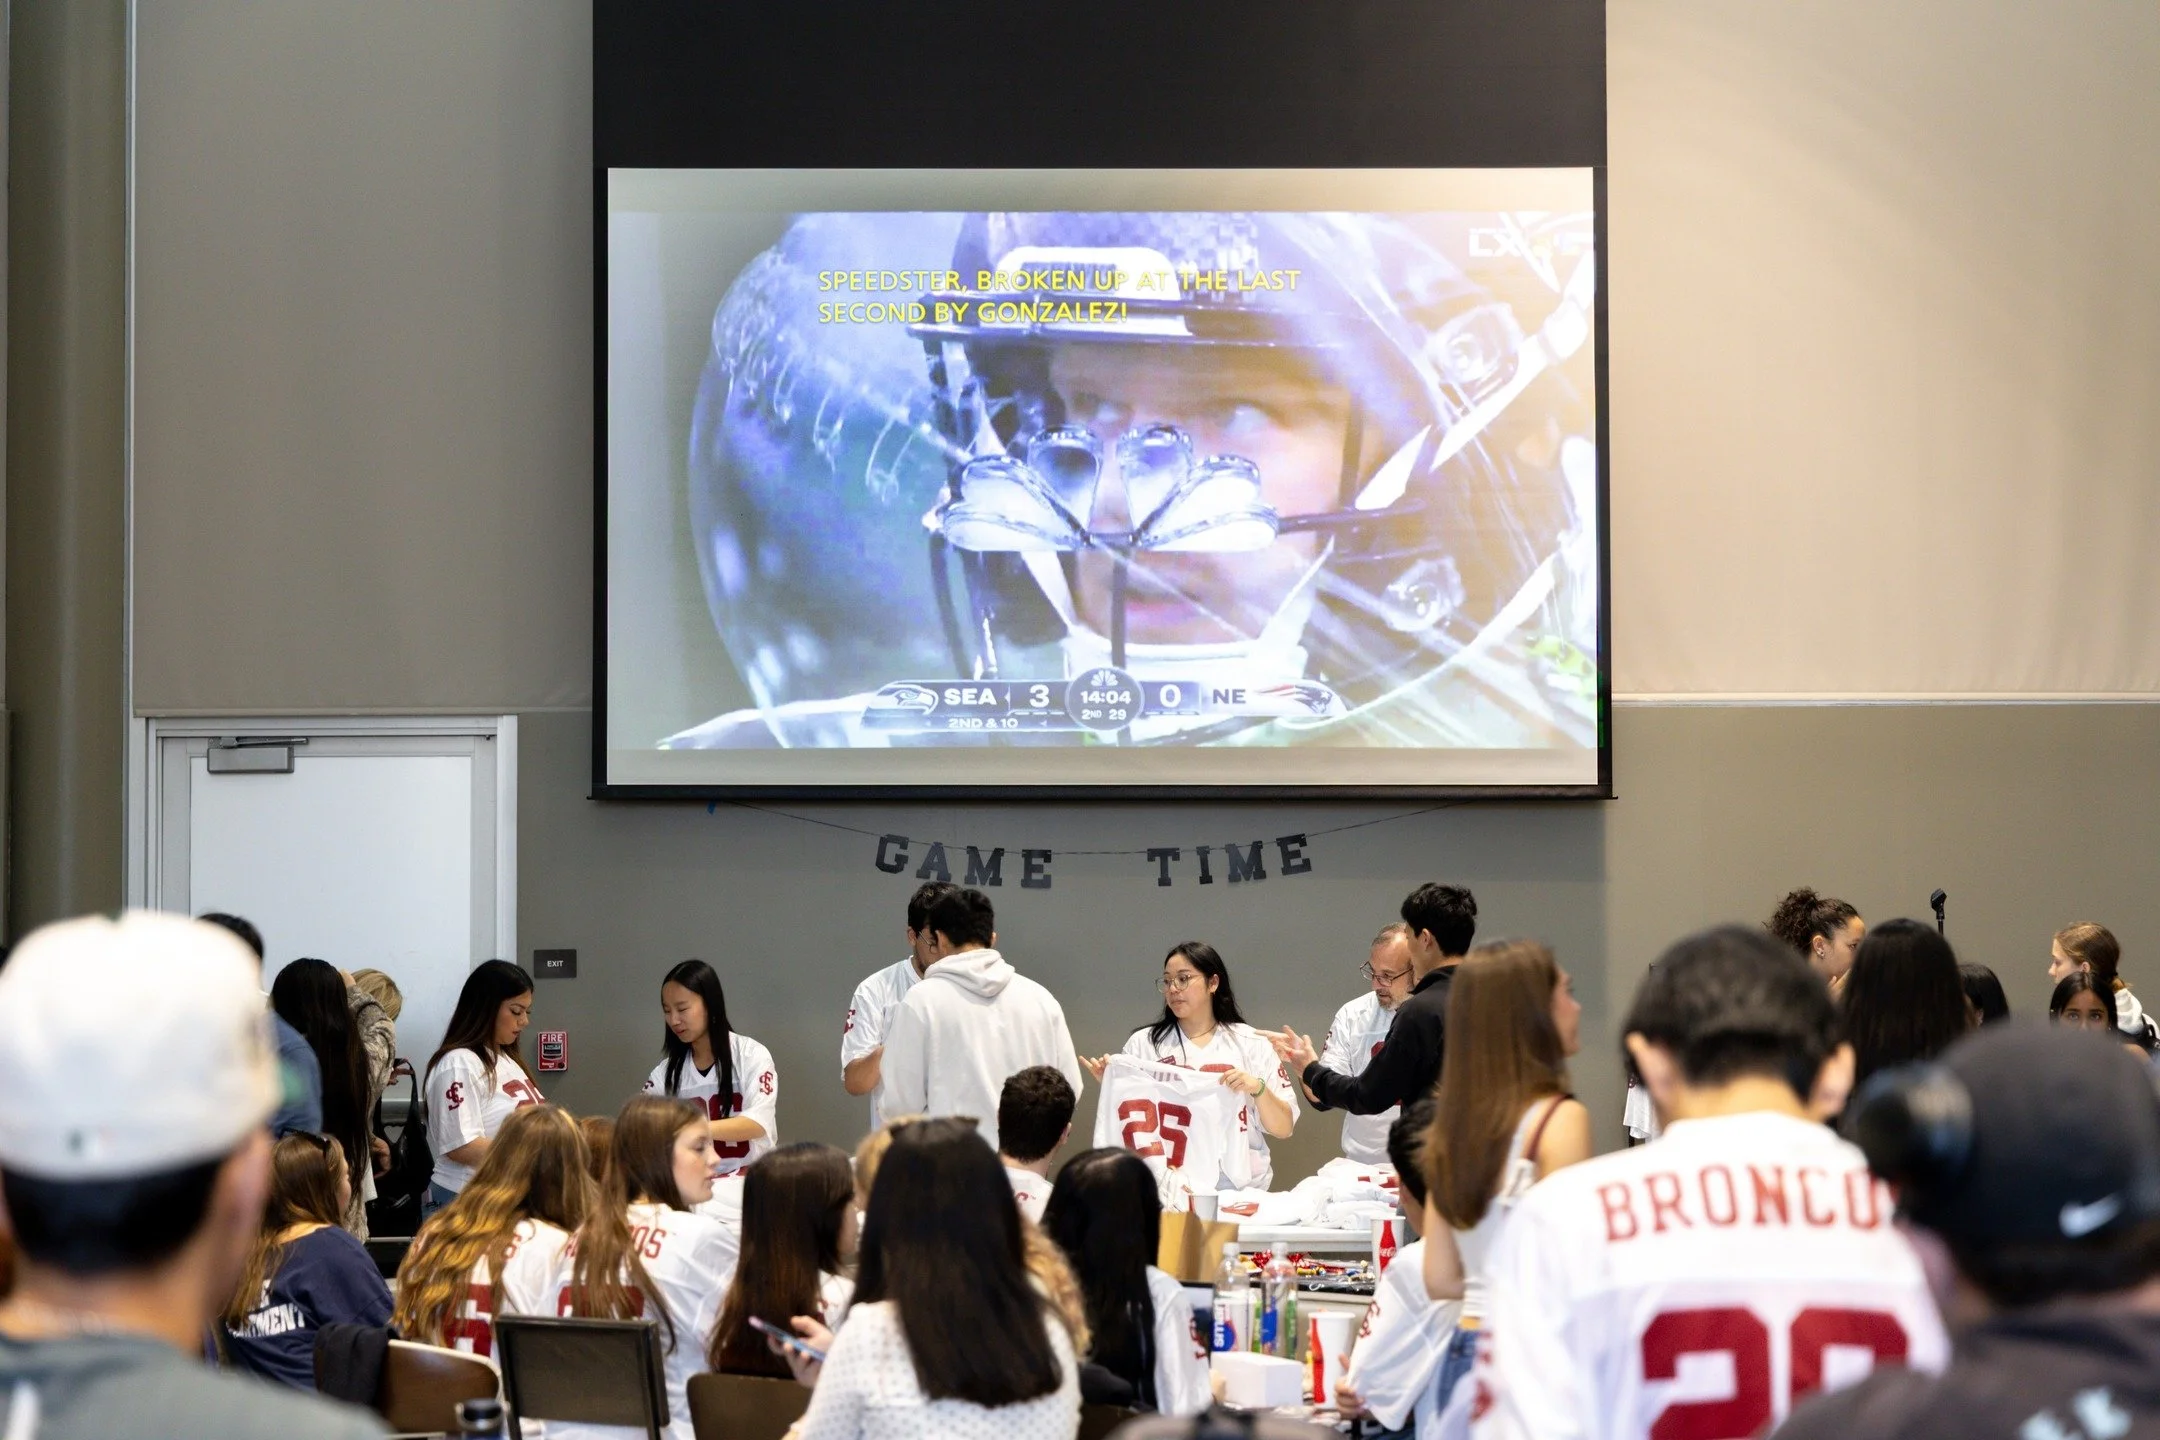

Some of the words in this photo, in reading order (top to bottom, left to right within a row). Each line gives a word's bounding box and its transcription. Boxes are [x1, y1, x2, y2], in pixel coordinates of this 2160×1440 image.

[818, 270, 968, 293] SPEEDSTER,
[976, 270, 1085, 292] BROKEN
[1094, 270, 1129, 292] UP
[1135, 270, 1170, 292] AT
[1177, 269, 1229, 292] THE
[1237, 269, 1302, 292] LAST
[818, 302, 927, 324] SECOND
[934, 302, 970, 323] BY
[977, 302, 1128, 324] GONZALEZ!
[943, 688, 997, 706] SEA
[1029, 684, 1050, 708] 3
[1080, 690, 1132, 705] 14:04
[1159, 684, 1182, 708] 0
[1212, 688, 1247, 705] NE
[948, 717, 983, 729] 2ND
[985, 717, 999, 729] &
[1000, 717, 1019, 729] 10
[1081, 708, 1102, 721] 2ND
[1108, 708, 1127, 721] 29
[875, 833, 1052, 889] GAME
[1146, 833, 1312, 887] TIME
[547, 960, 564, 968] EXIT
[541, 1033, 563, 1042] FIRE
[1595, 1164, 1899, 1243] BRONCO
